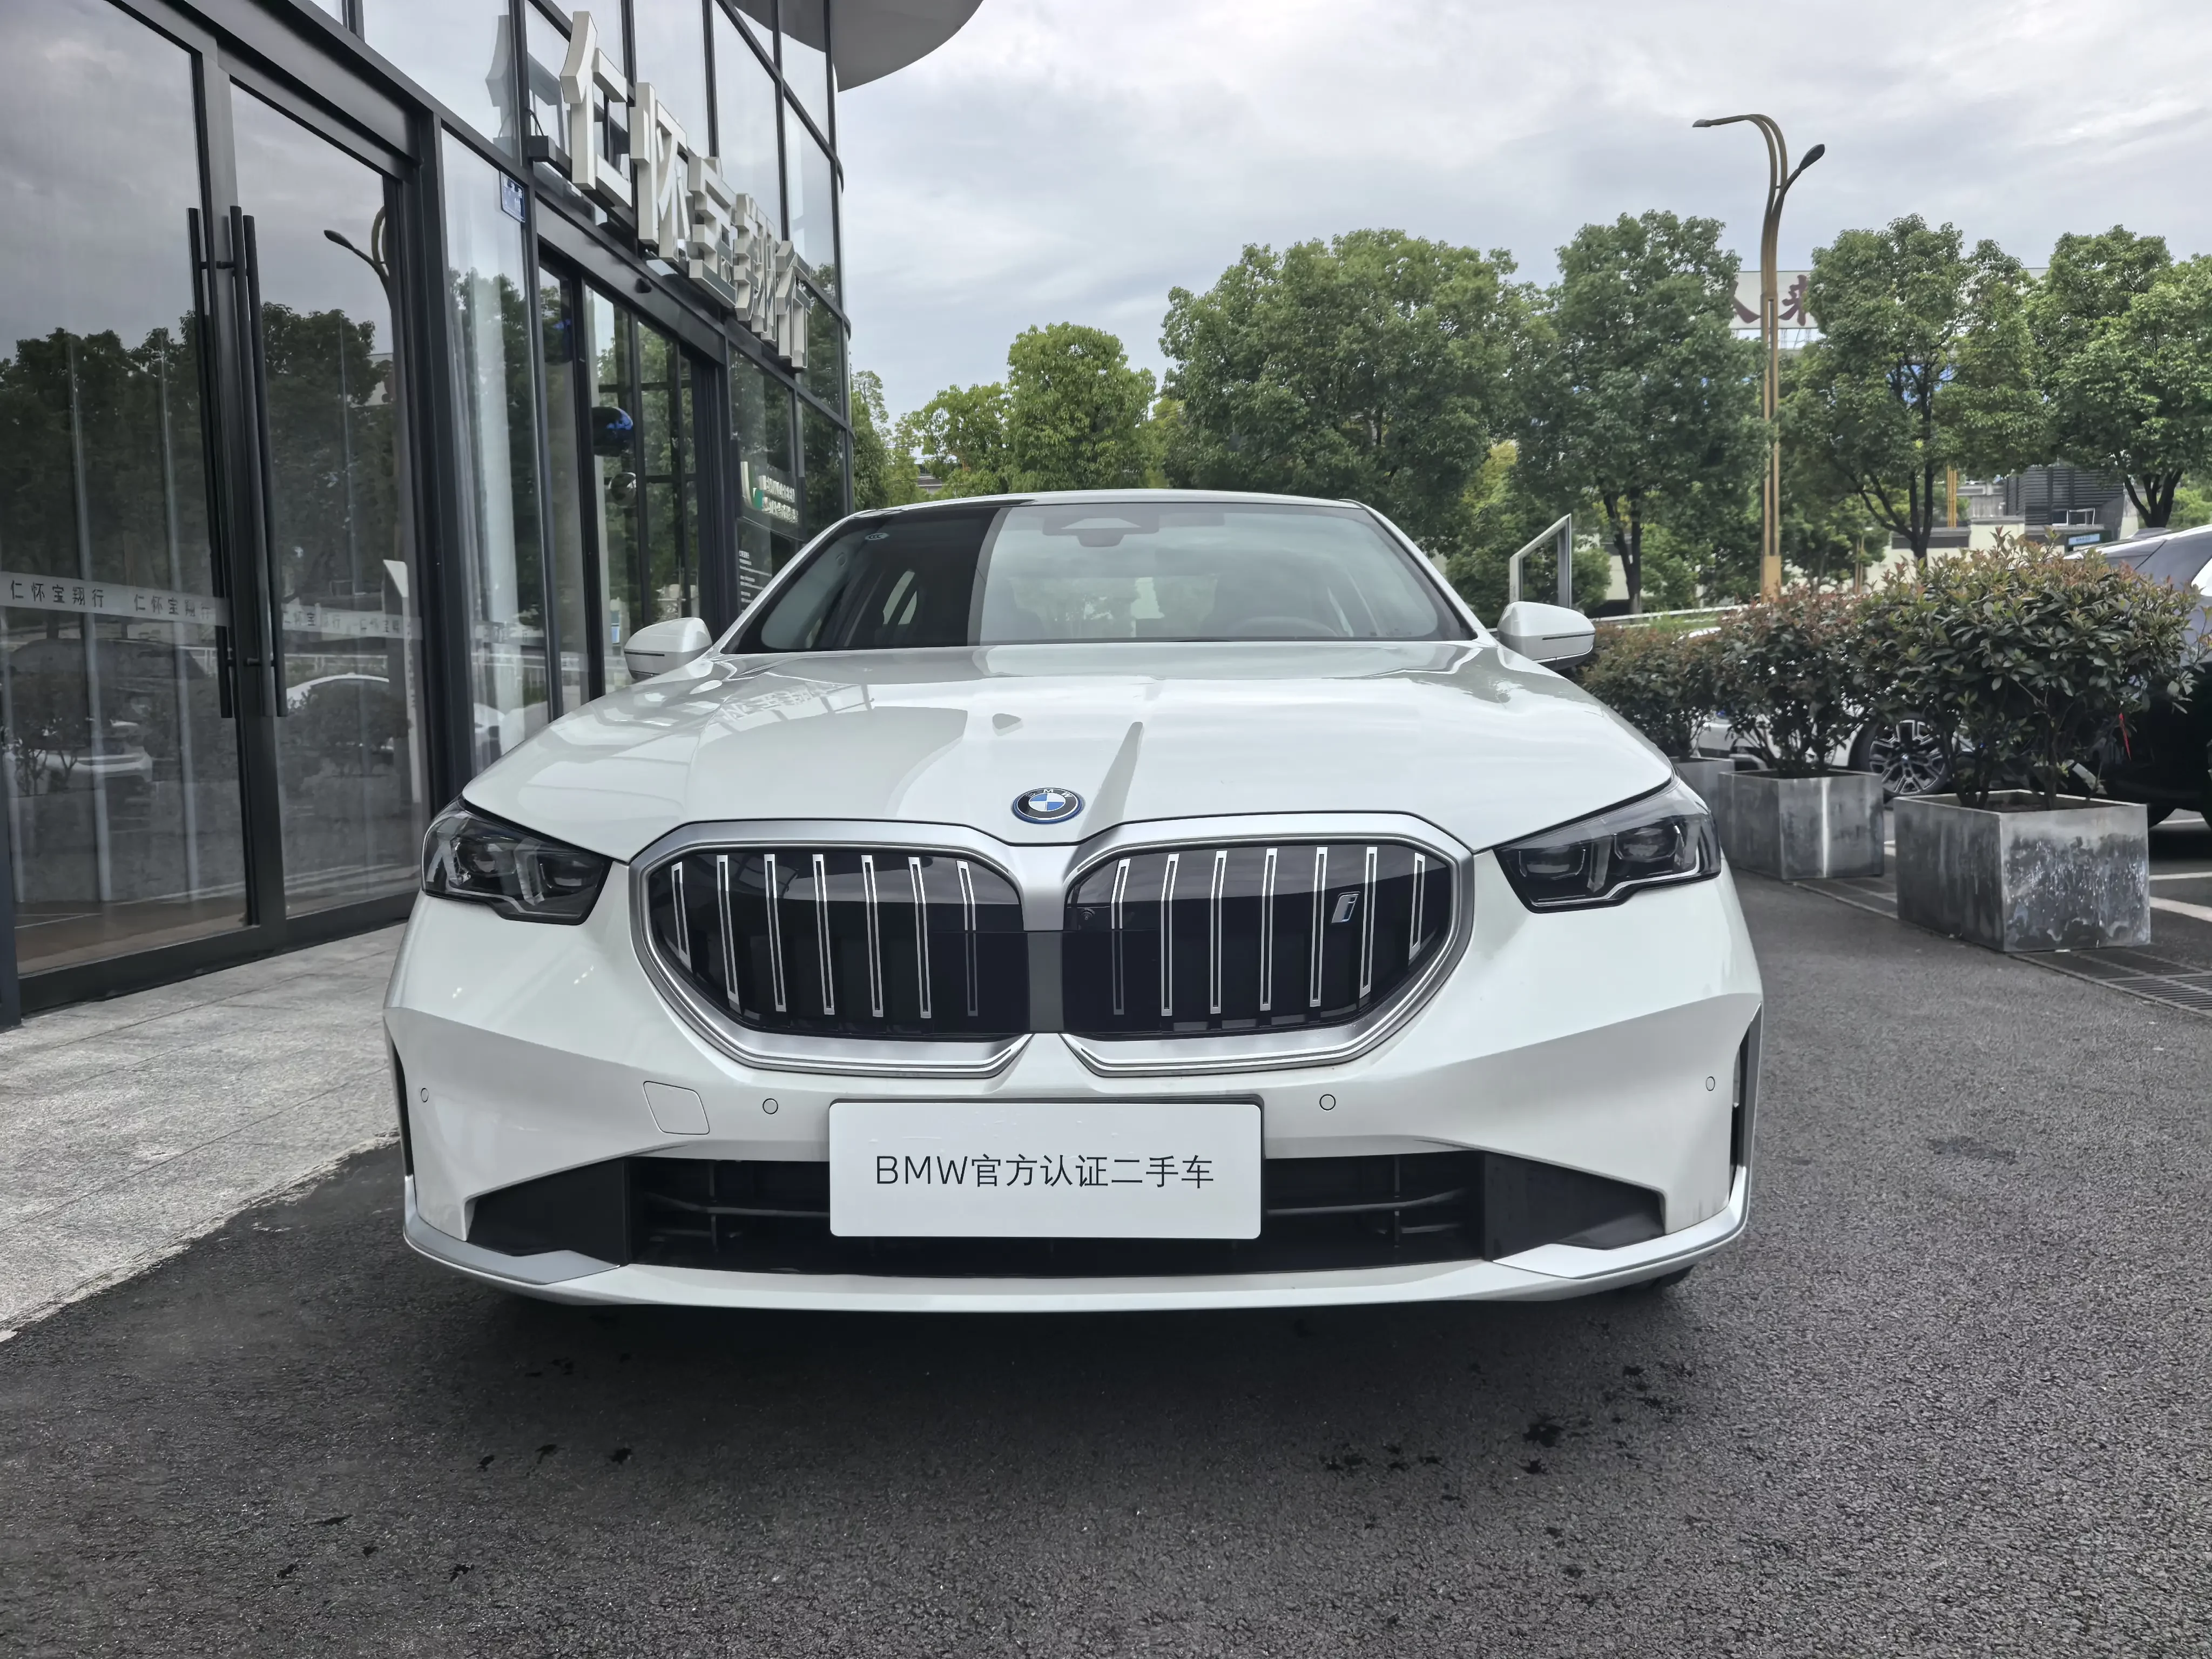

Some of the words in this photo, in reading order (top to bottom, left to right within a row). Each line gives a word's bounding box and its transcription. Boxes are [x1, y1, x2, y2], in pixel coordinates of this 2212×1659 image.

[10, 580, 104, 608] 仁怀宝翔行
[1026, 788, 1073, 798] BMW
[876, 1154, 1214, 1189] BMW官方认证二手车
